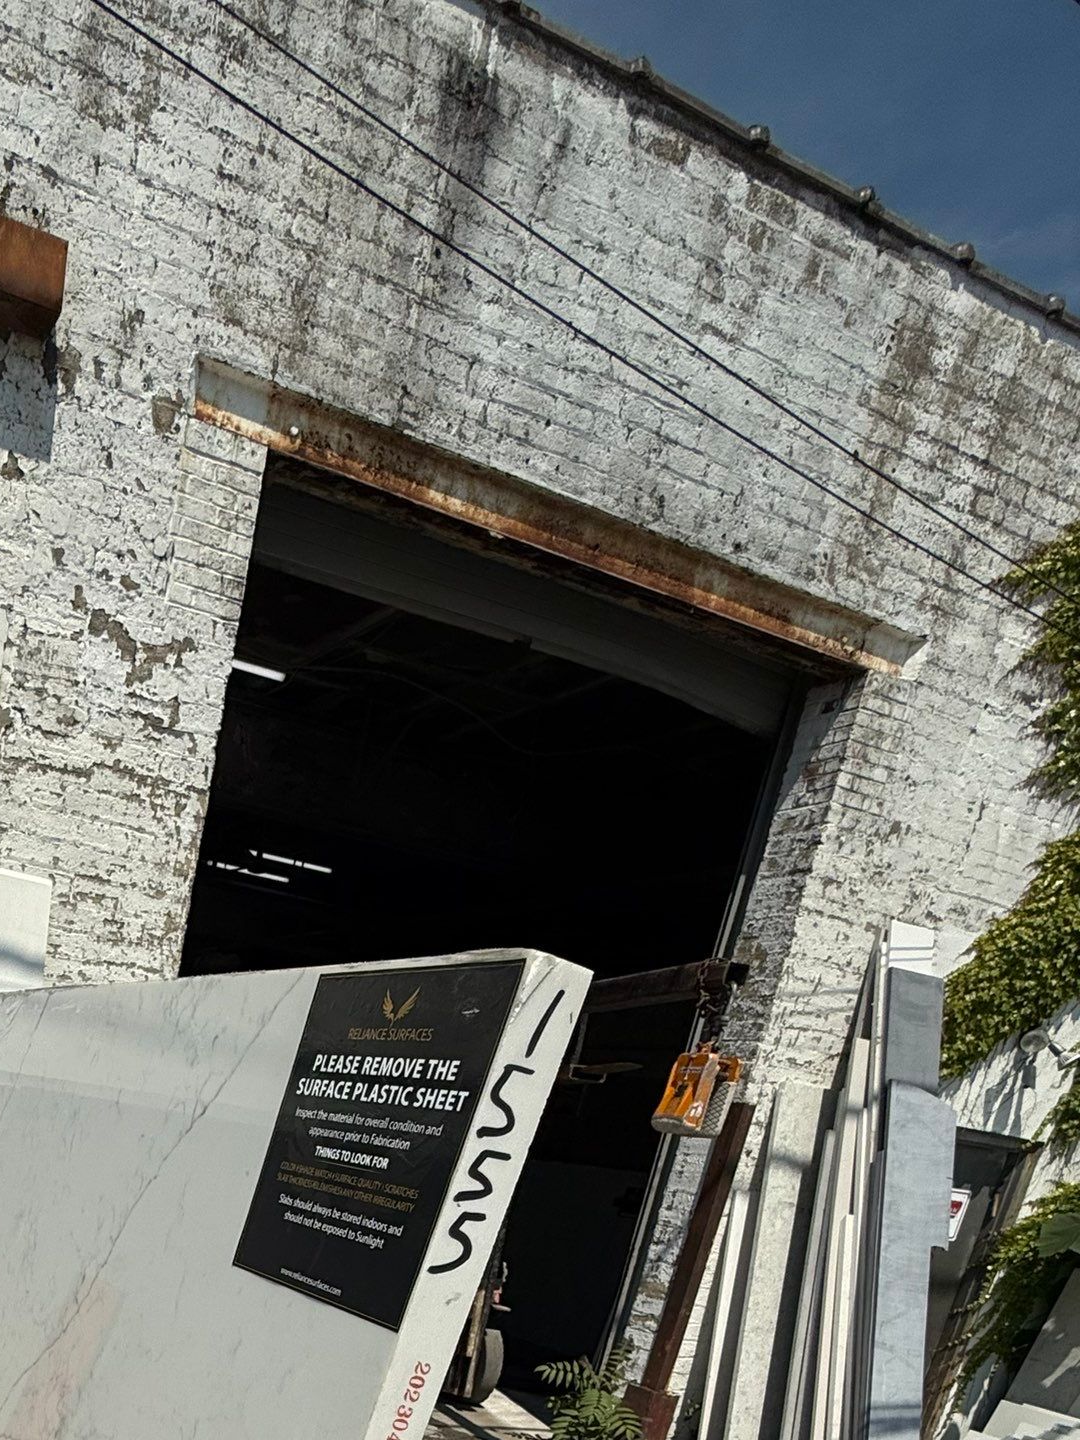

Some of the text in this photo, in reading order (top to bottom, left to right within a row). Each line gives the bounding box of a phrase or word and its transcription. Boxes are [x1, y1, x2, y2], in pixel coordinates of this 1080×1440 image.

[348, 1027, 434, 1042] RELIANCE SURFACES
[312, 1054, 461, 1081] PLEASE REMOVE THE
[296, 1077, 469, 1112] SURFACE PLASTIC SHEET
[295, 1107, 443, 1137] Inspect the material for overall condition and
[308, 1126, 411, 1151] appearance prior to Fabrication
[314, 1145, 390, 1170] THINGS TO LOOK FOR
[283, 1210, 385, 1249] should not be exposed to Sunlight
[293, 1196, 312, 1212] should
[312, 1201, 332, 1218] always
[331, 1205, 341, 1219] be
[341, 1210, 362, 1225] stored
[362, 1214, 387, 1233] indoors
[387, 1225, 404, 1237] and
[280, 1267, 342, 1297] www.reliancesurfaces.com
